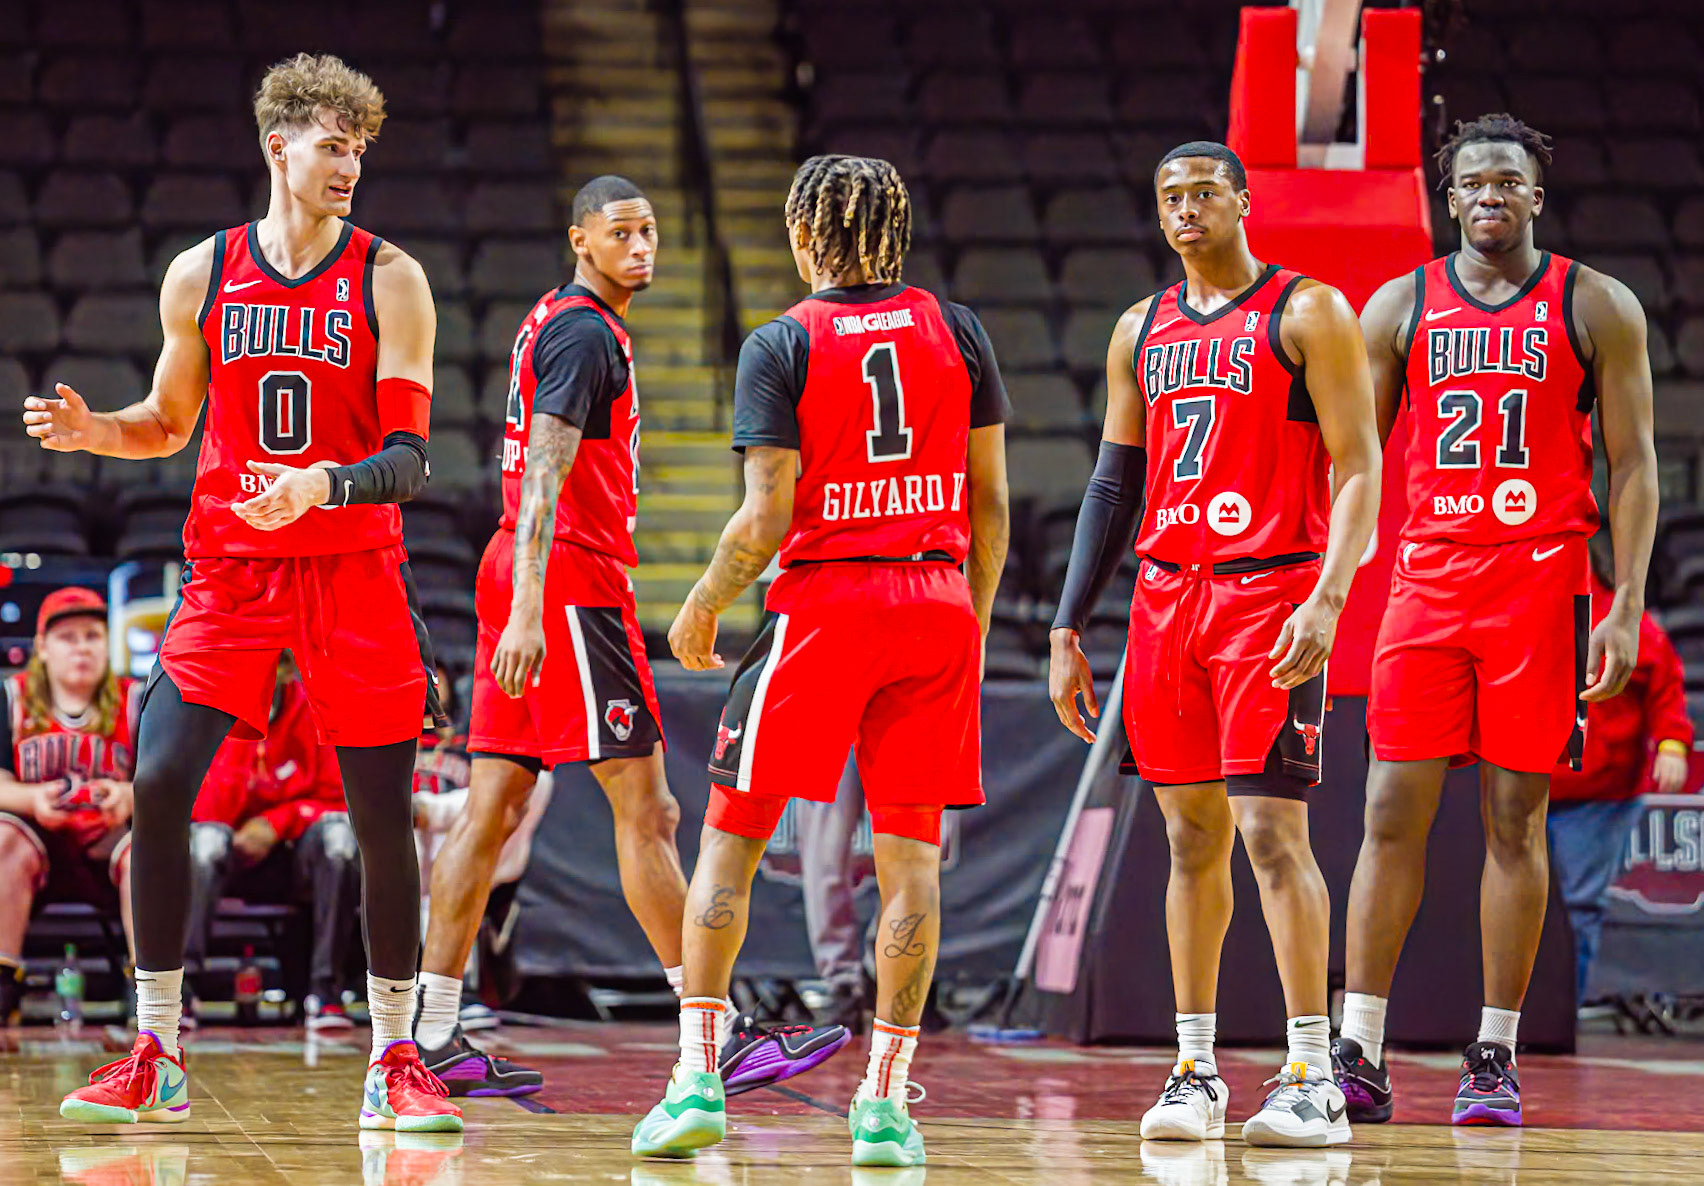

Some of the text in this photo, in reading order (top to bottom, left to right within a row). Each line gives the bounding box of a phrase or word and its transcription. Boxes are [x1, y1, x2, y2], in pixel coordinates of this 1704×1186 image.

[221, 303, 352, 369] BULLS
[1428, 327, 1548, 387] BULLS
[861, 341, 913, 464] 1
[1144, 336, 1256, 407] BULLS
[258, 370, 312, 455] 0
[1171, 395, 1216, 483] 7
[1436, 389, 1530, 470] 21
[822, 474, 945, 521] GILYARD
[1156, 503, 1201, 531] BMO
[1433, 495, 1485, 515] BMO
